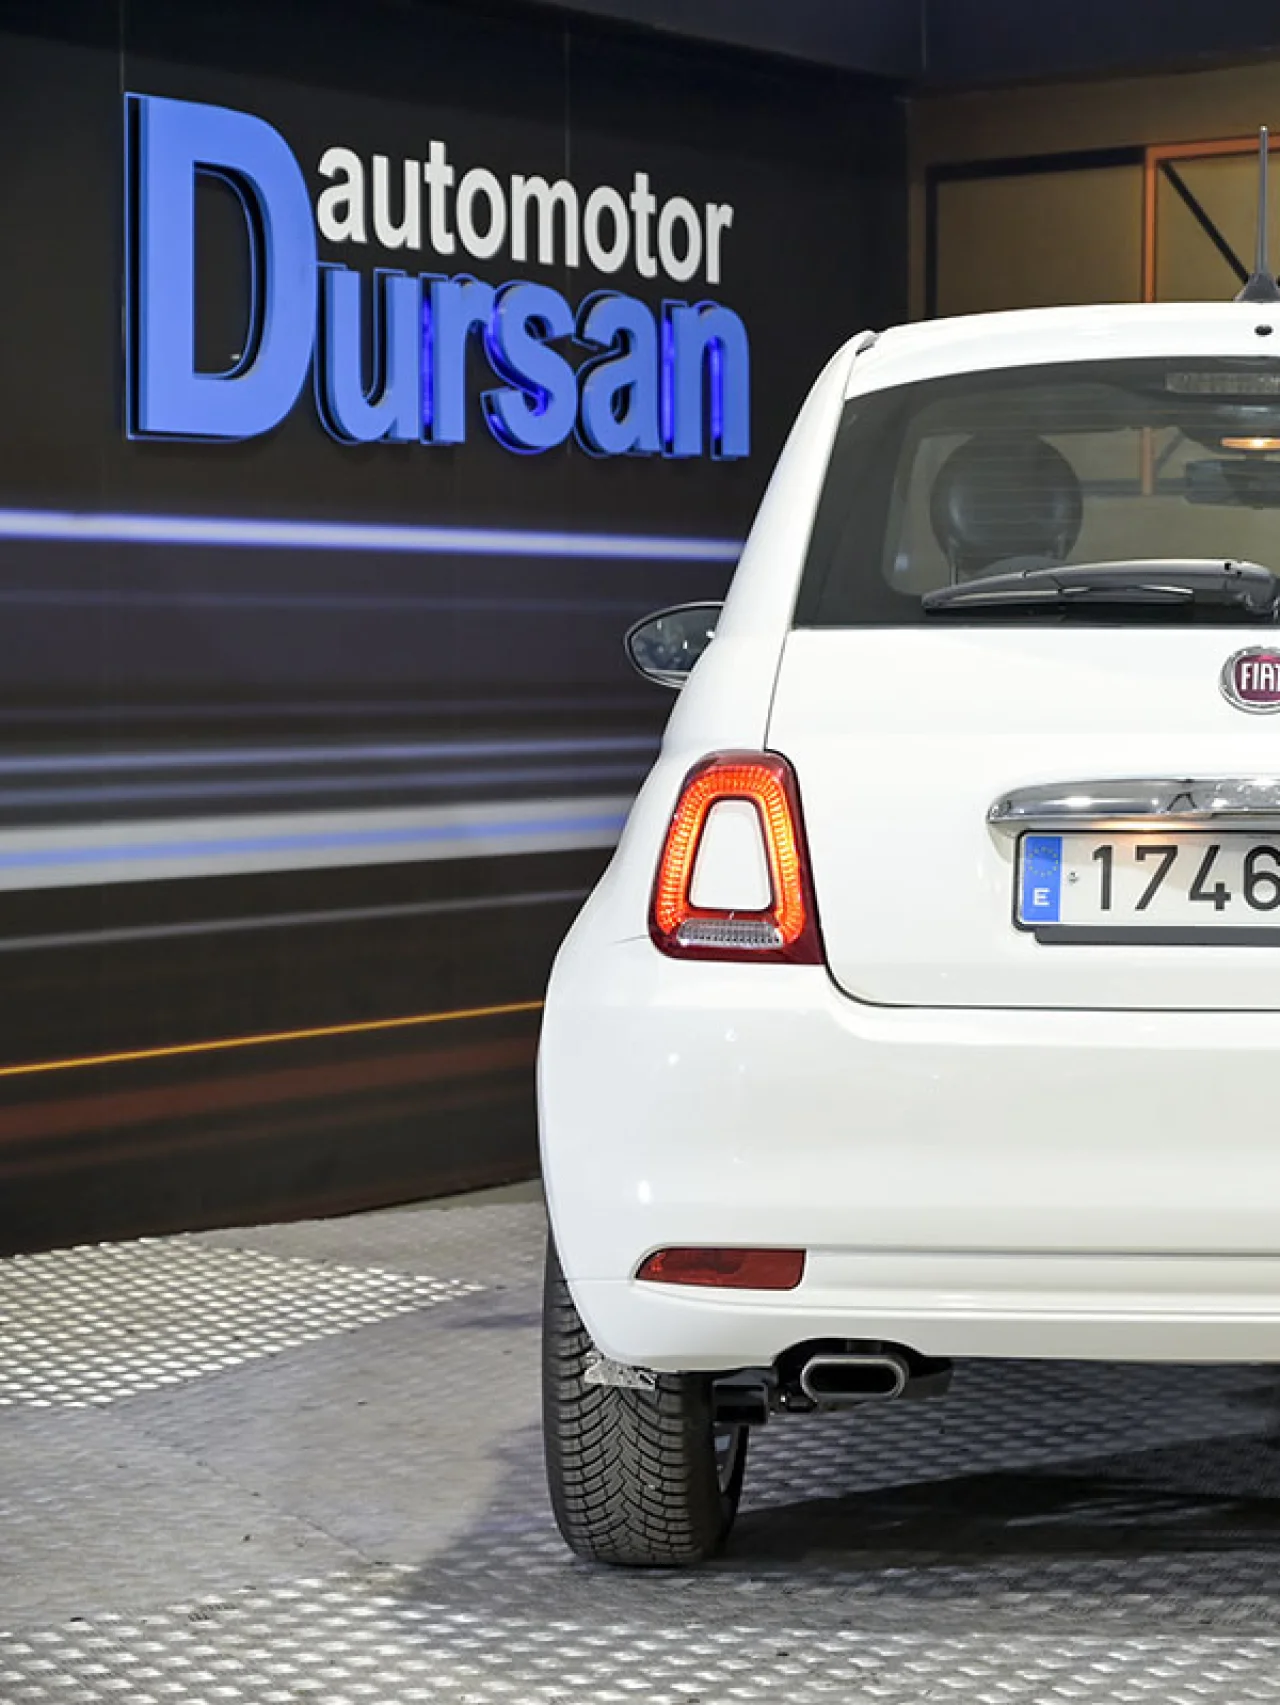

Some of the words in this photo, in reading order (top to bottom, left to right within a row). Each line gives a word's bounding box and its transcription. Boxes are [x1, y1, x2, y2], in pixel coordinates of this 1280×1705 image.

[125, 91, 751, 460] Dursan
[316, 140, 733, 284] automotor
[1033, 887, 1050, 906] E
